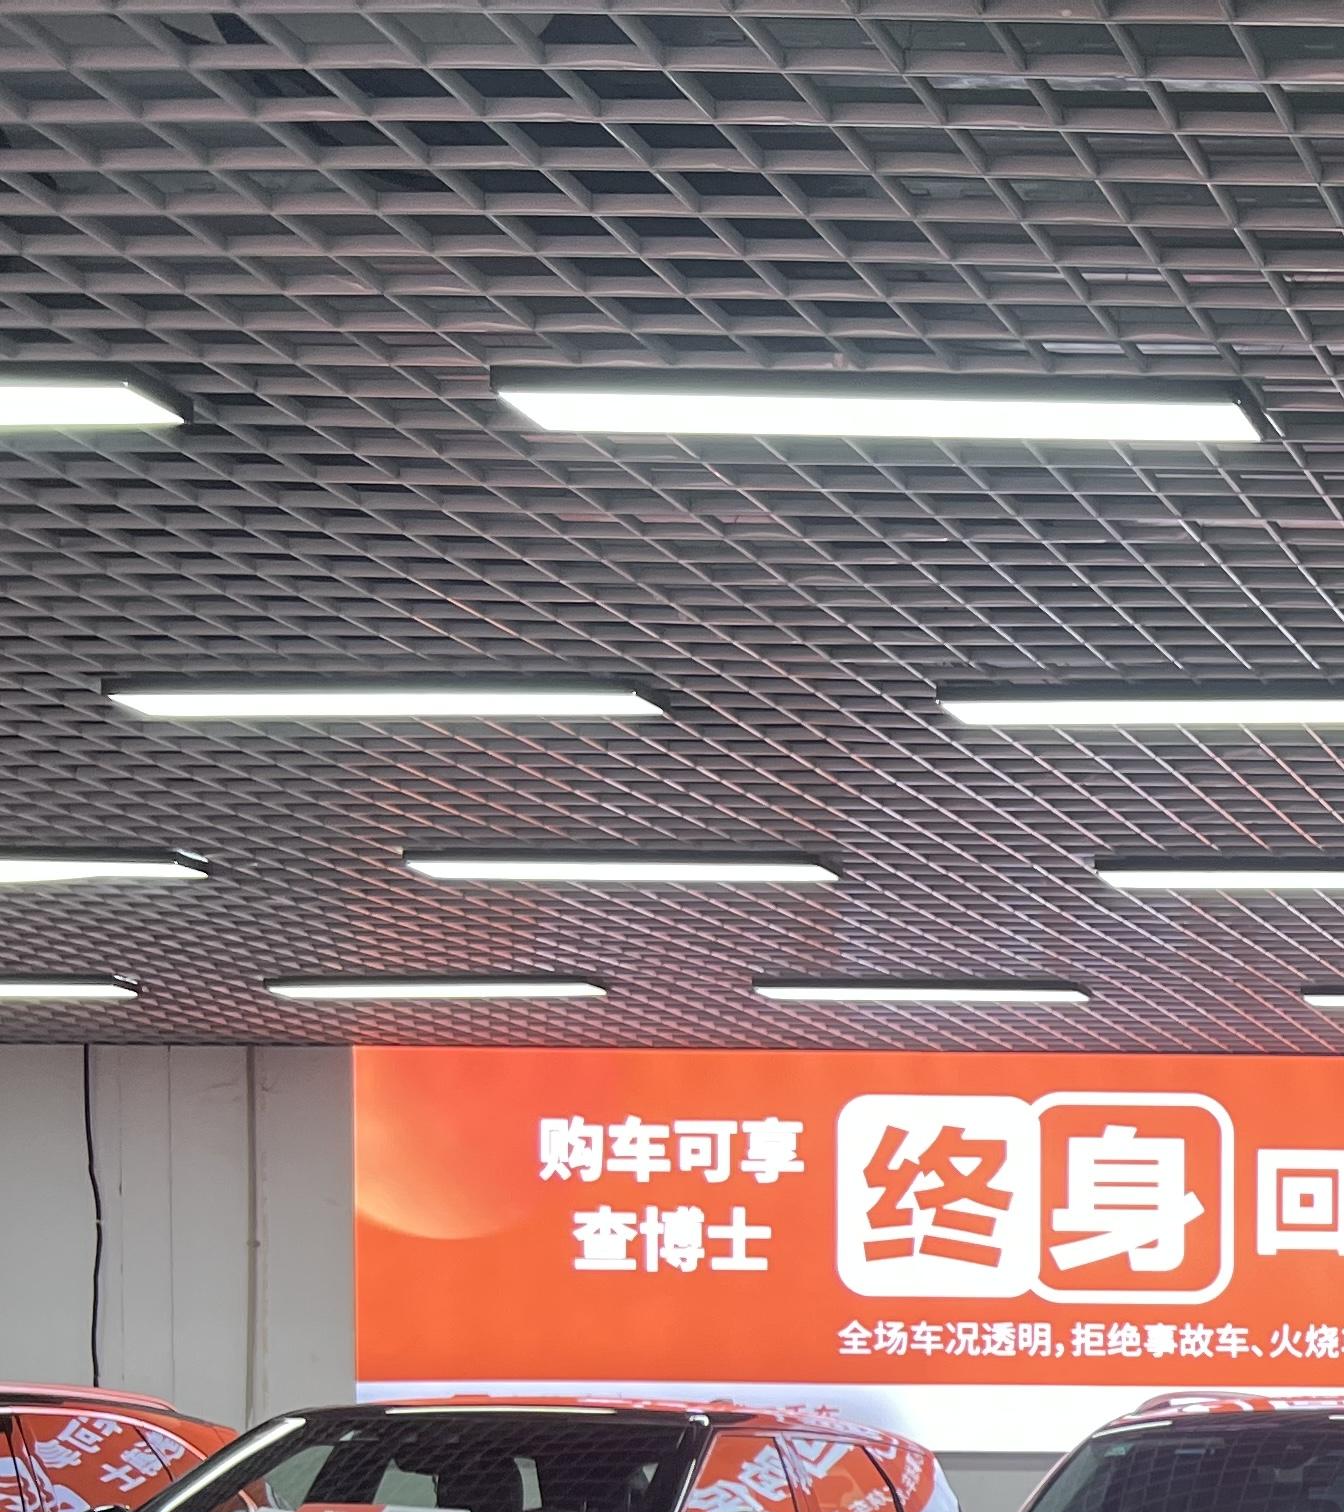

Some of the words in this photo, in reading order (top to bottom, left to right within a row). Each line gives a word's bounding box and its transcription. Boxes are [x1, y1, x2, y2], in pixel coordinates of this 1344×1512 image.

[539, 1115, 805, 1184] 购车可享
[864, 1124, 1205, 1272] 终身
[572, 1205, 772, 1273] 查博士
